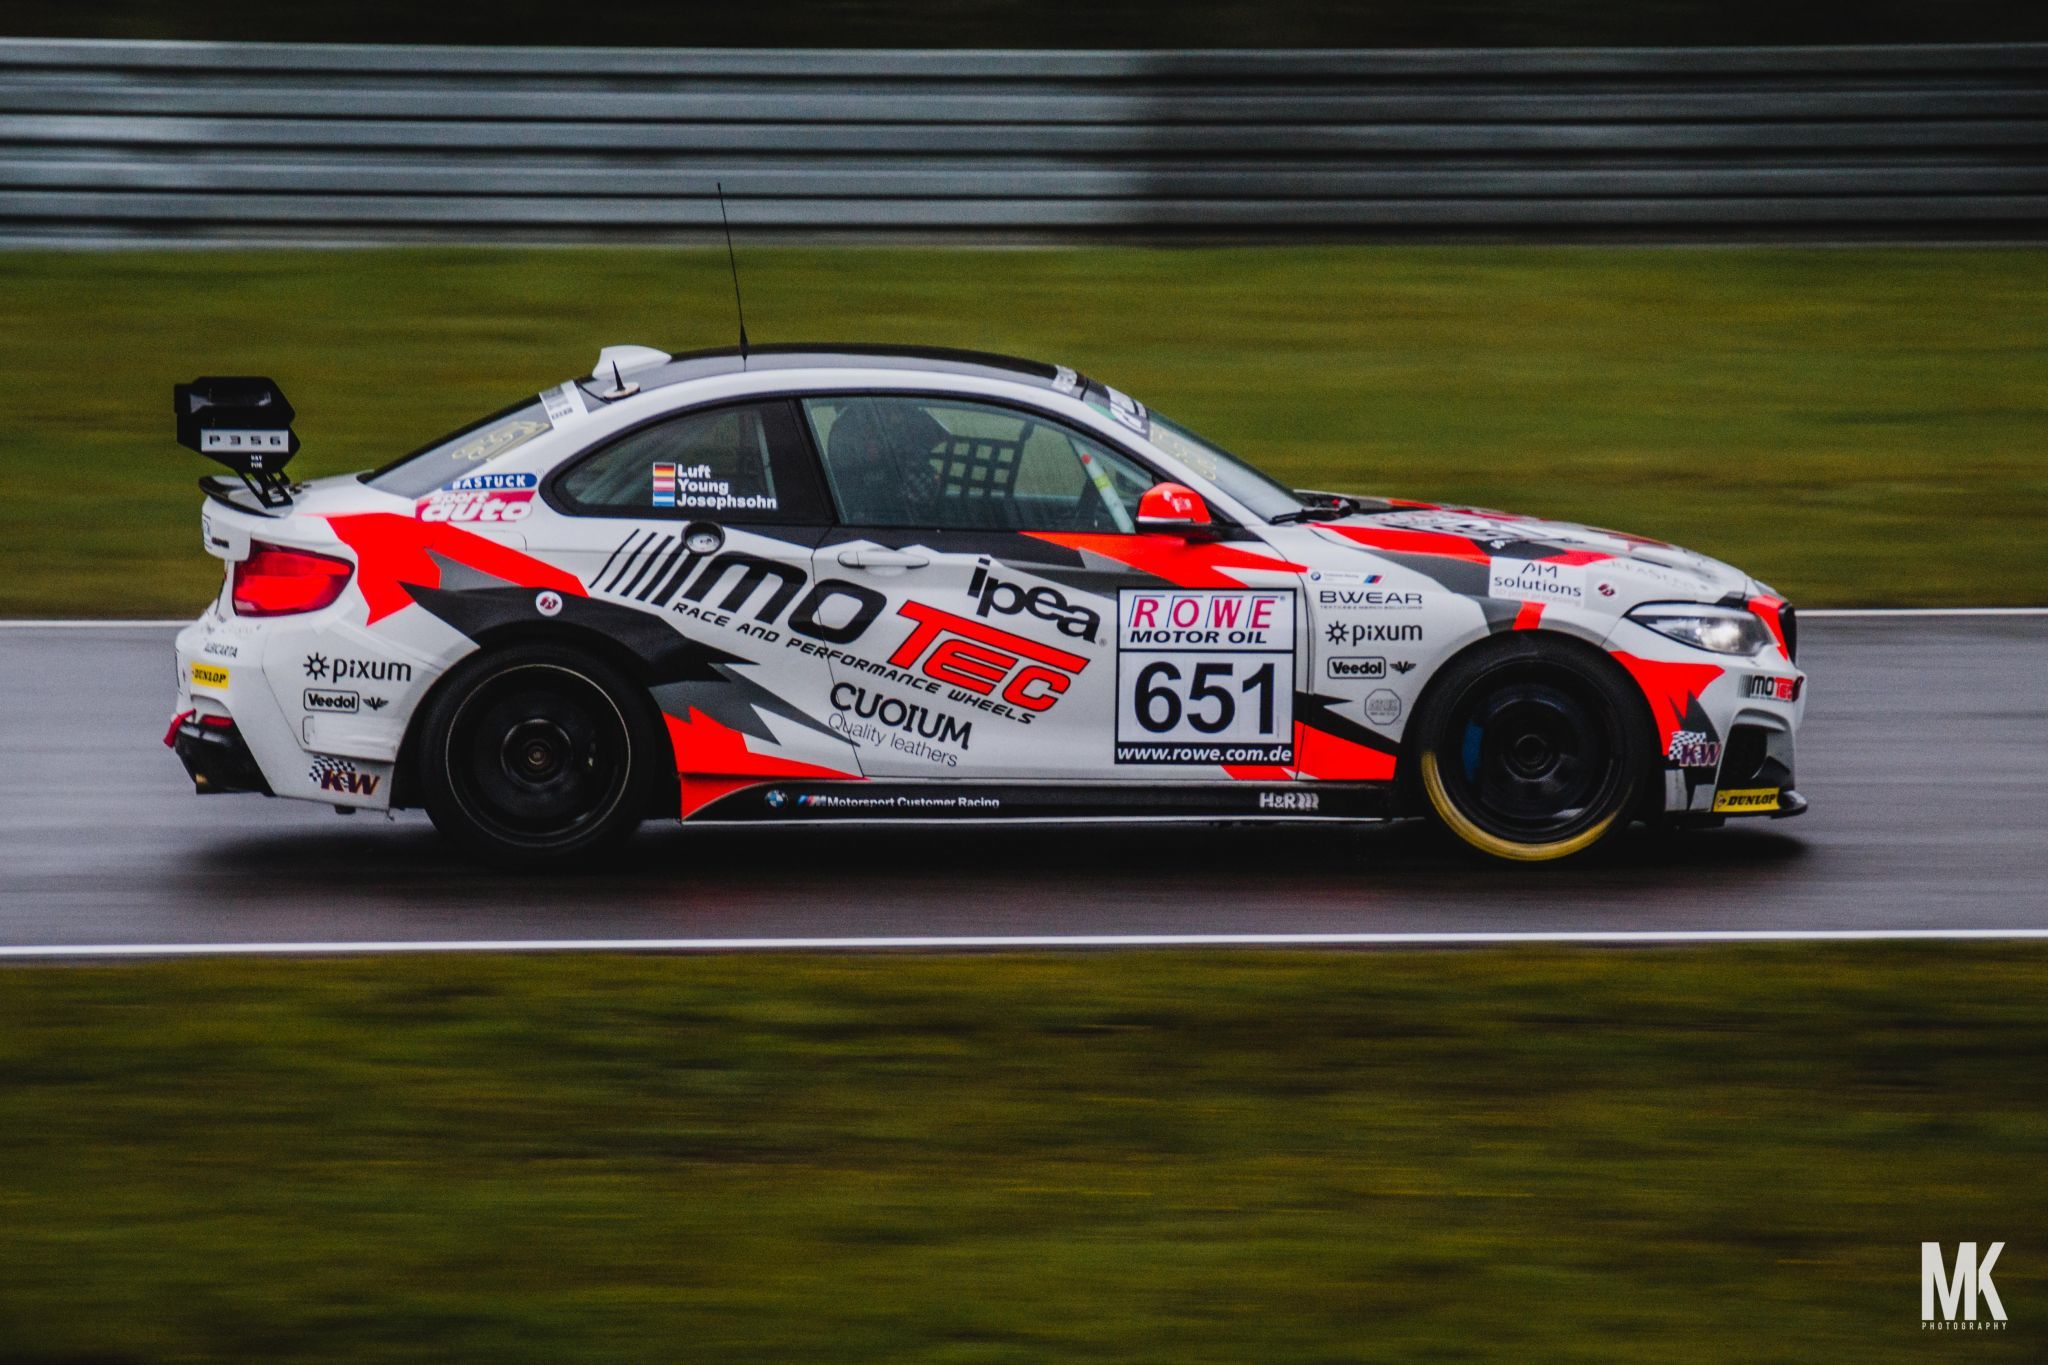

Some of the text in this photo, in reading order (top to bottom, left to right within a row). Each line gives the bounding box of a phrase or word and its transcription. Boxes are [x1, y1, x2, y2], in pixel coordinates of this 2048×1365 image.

[677, 463, 711, 479] Luft
[677, 478, 729, 495] Young
[420, 499, 534, 523] auto
[676, 493, 777, 511] Josephsohn
[1494, 576, 1582, 597] solutions
[966, 557, 1101, 644] ipea
[1319, 590, 1423, 604] BWEAR
[1130, 596, 1277, 629] ROWE
[1130, 630, 1267, 645] MOTOR OIL
[1352, 624, 1423, 647] pixum
[332, 658, 412, 684] pixum
[672, 602, 1036, 725] RACE AND PERFORMANCE WHEELS
[1331, 661, 1382, 675] Veedol
[193, 668, 227, 684] DUNLOP
[307, 693, 356, 709] Veedol
[1134, 661, 1275, 734] 651
[827, 712, 958, 768] Quality leathers
[1117, 745, 1292, 763] www.rowe.com.de
[1678, 741, 1722, 767] KW
[320, 768, 381, 796] KW
[827, 796, 895, 808] Motorsport
[897, 796, 956, 808] Customer
[958, 796, 1000, 809] Racing
[1259, 792, 1297, 809] H&R
[1727, 793, 1778, 807] DUNLOP
